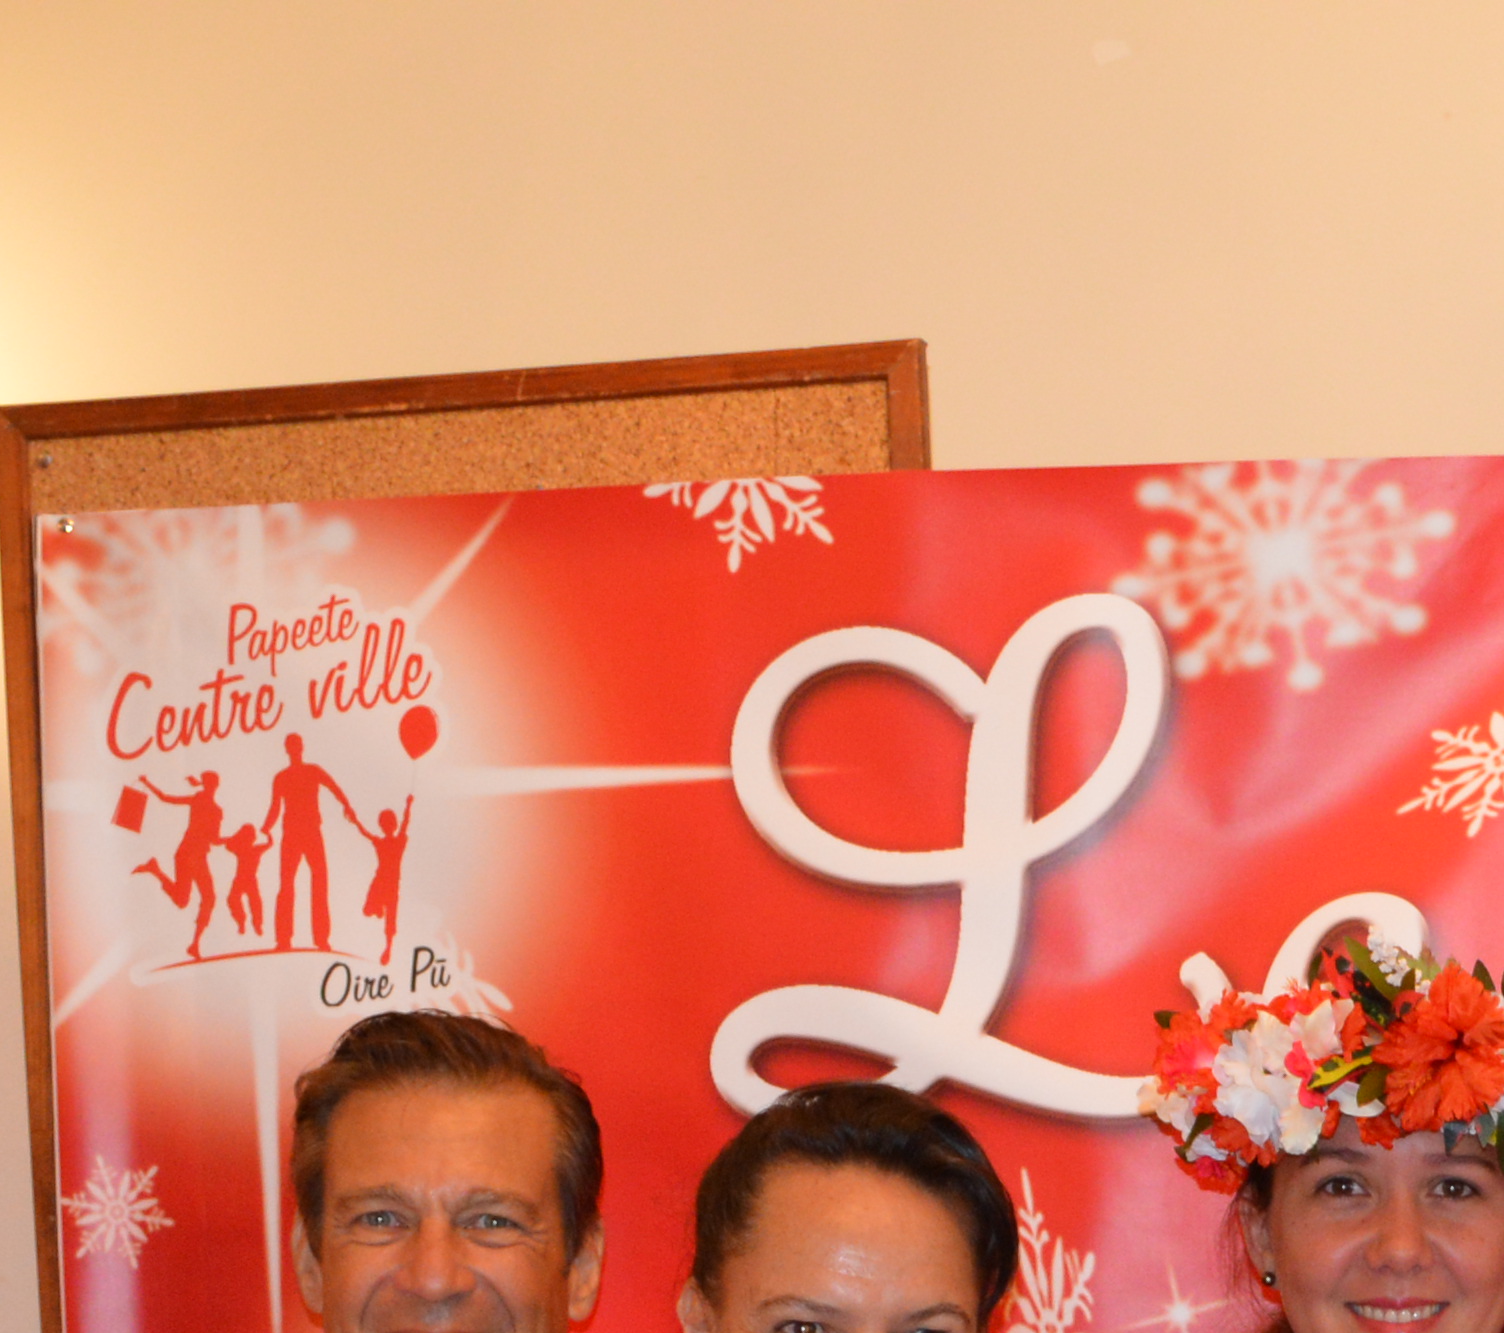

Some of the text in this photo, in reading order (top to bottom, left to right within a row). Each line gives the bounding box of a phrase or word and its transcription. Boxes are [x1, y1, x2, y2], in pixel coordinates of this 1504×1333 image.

[228, 594, 358, 675] Papeete
[106, 618, 431, 760] Centre ville
[320, 946, 450, 1006] Oire Pū
